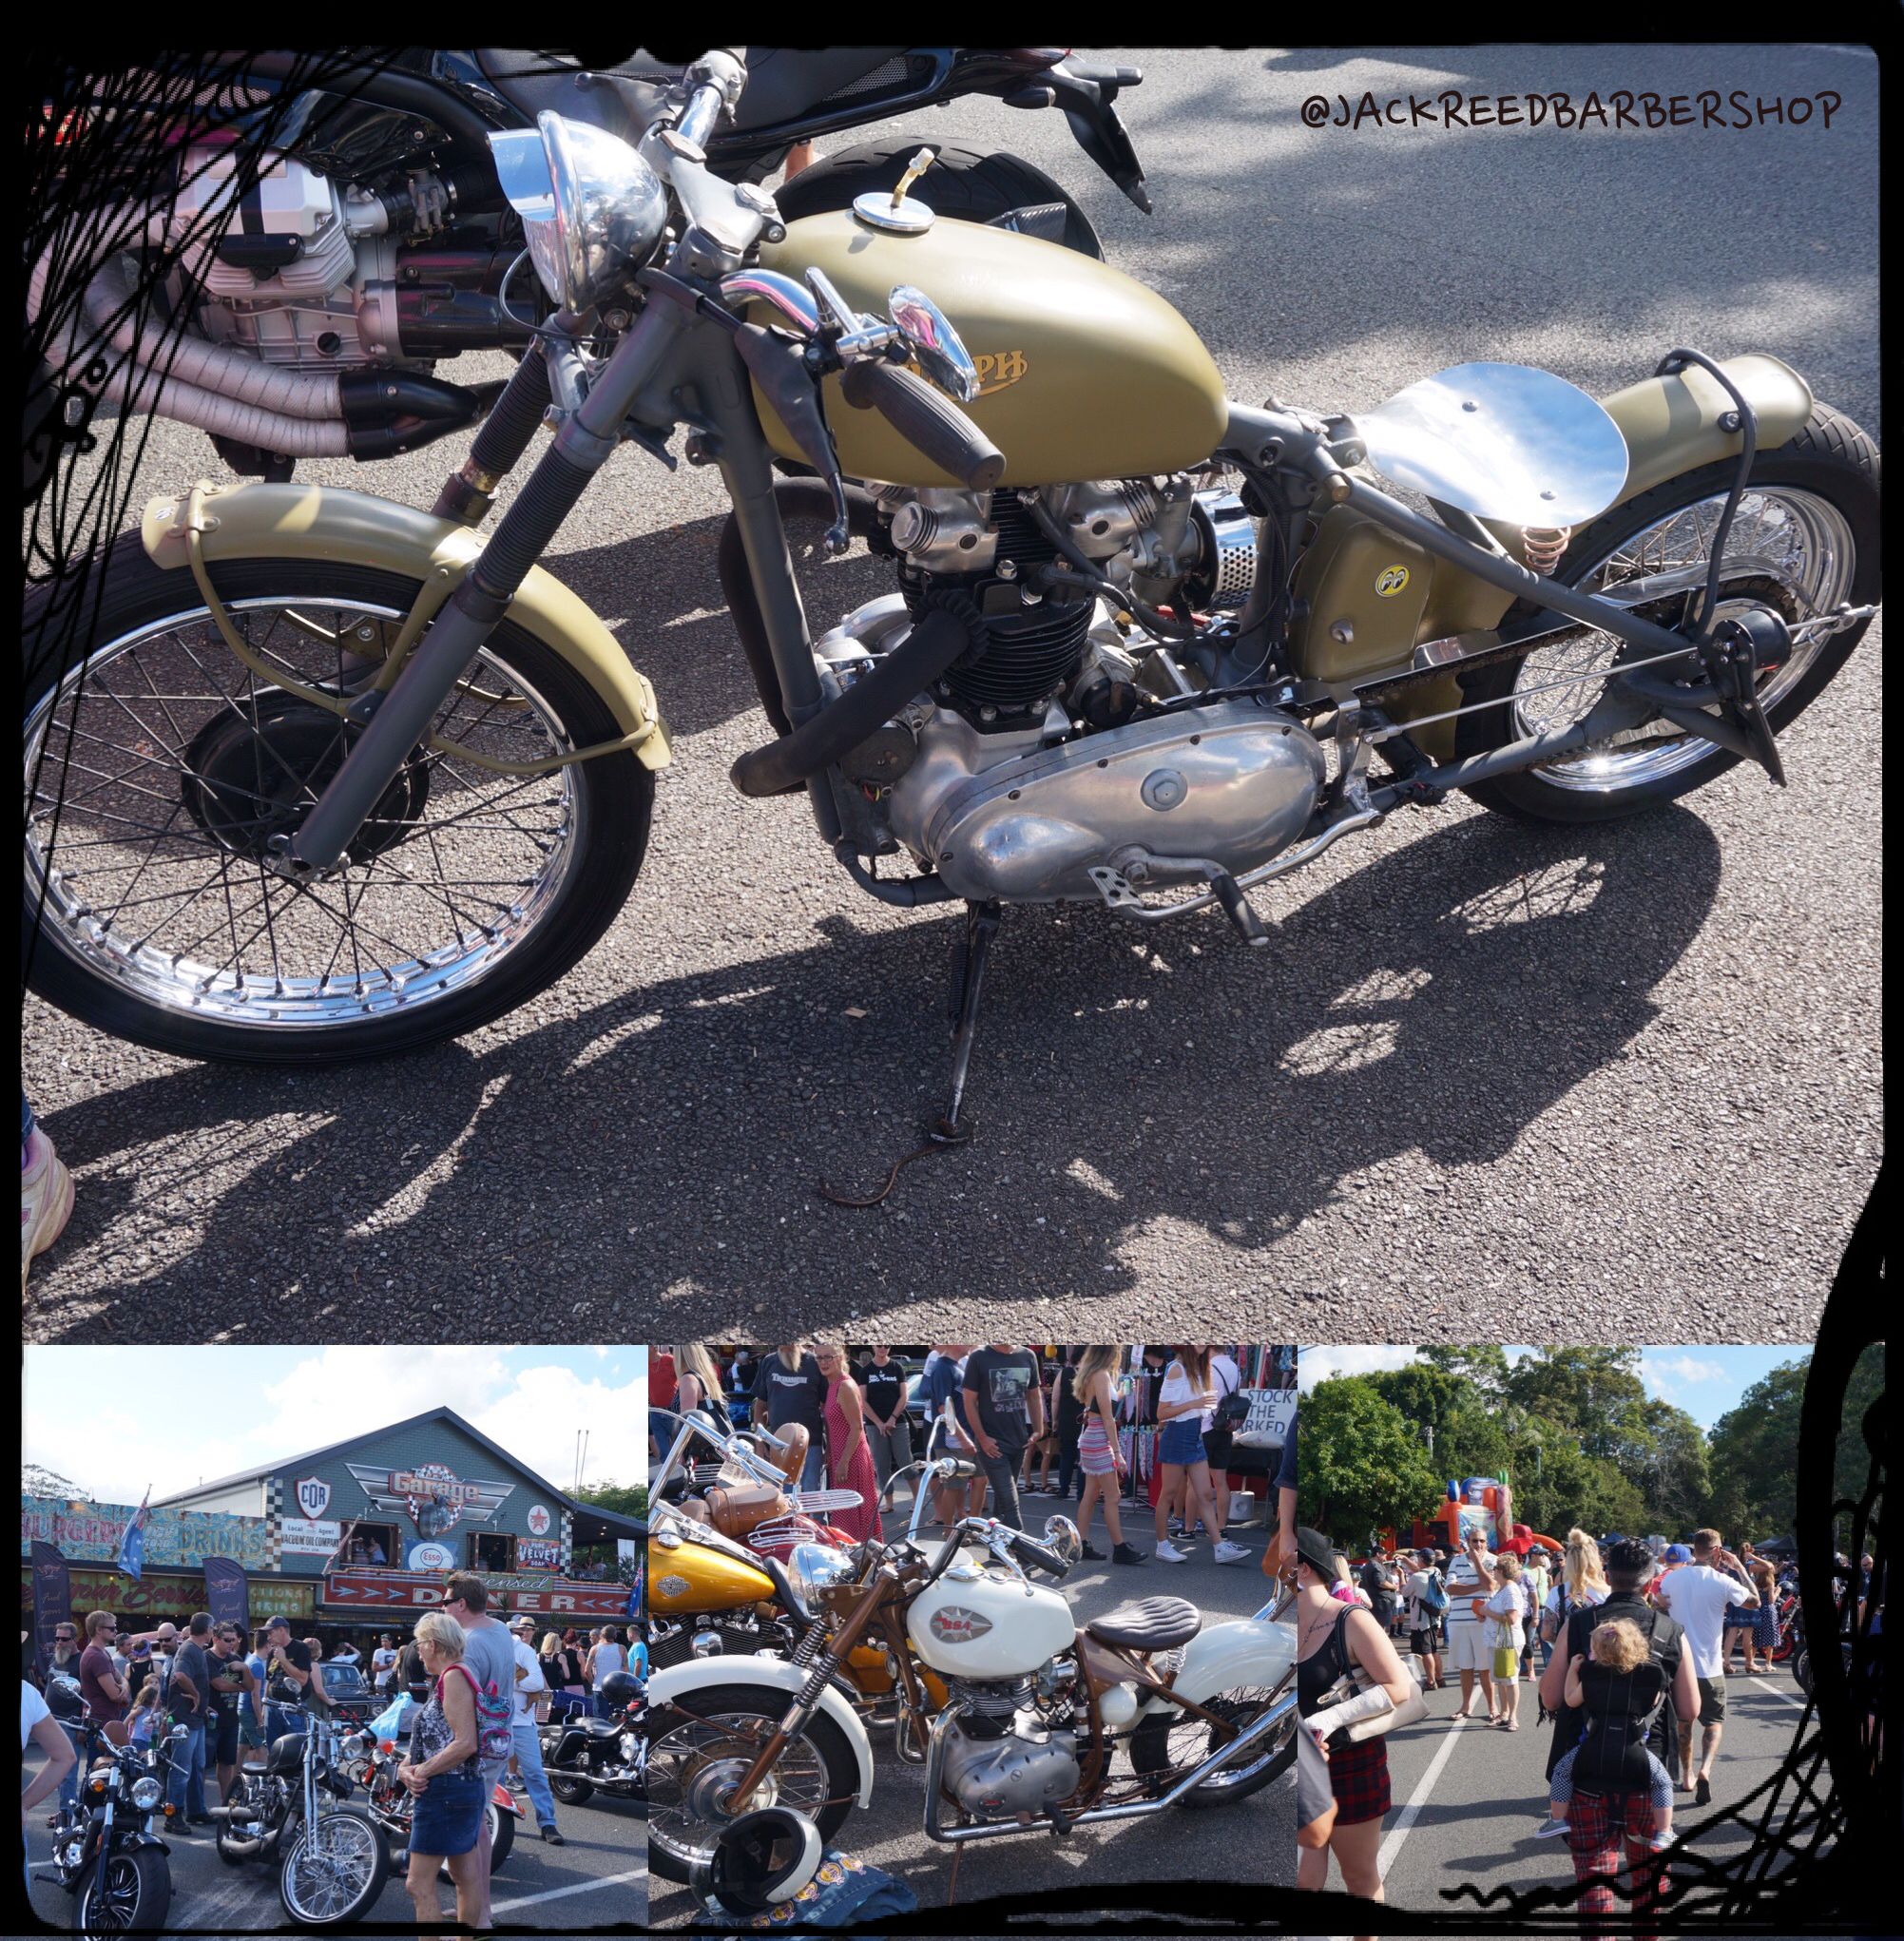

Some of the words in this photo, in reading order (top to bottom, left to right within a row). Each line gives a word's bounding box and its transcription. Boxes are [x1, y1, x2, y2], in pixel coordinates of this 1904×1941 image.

[1248, 1389, 1294, 1404] STOCK
[1249, 1405, 1277, 1418] THE
[301, 1484, 326, 1509] COR
[394, 1472, 480, 1504] Garage
[423, 1551, 441, 1562] Esso
[519, 1545, 559, 1564] VELVET
[467, 1570, 549, 1589] censed
[412, 1587, 576, 1610] DNER
